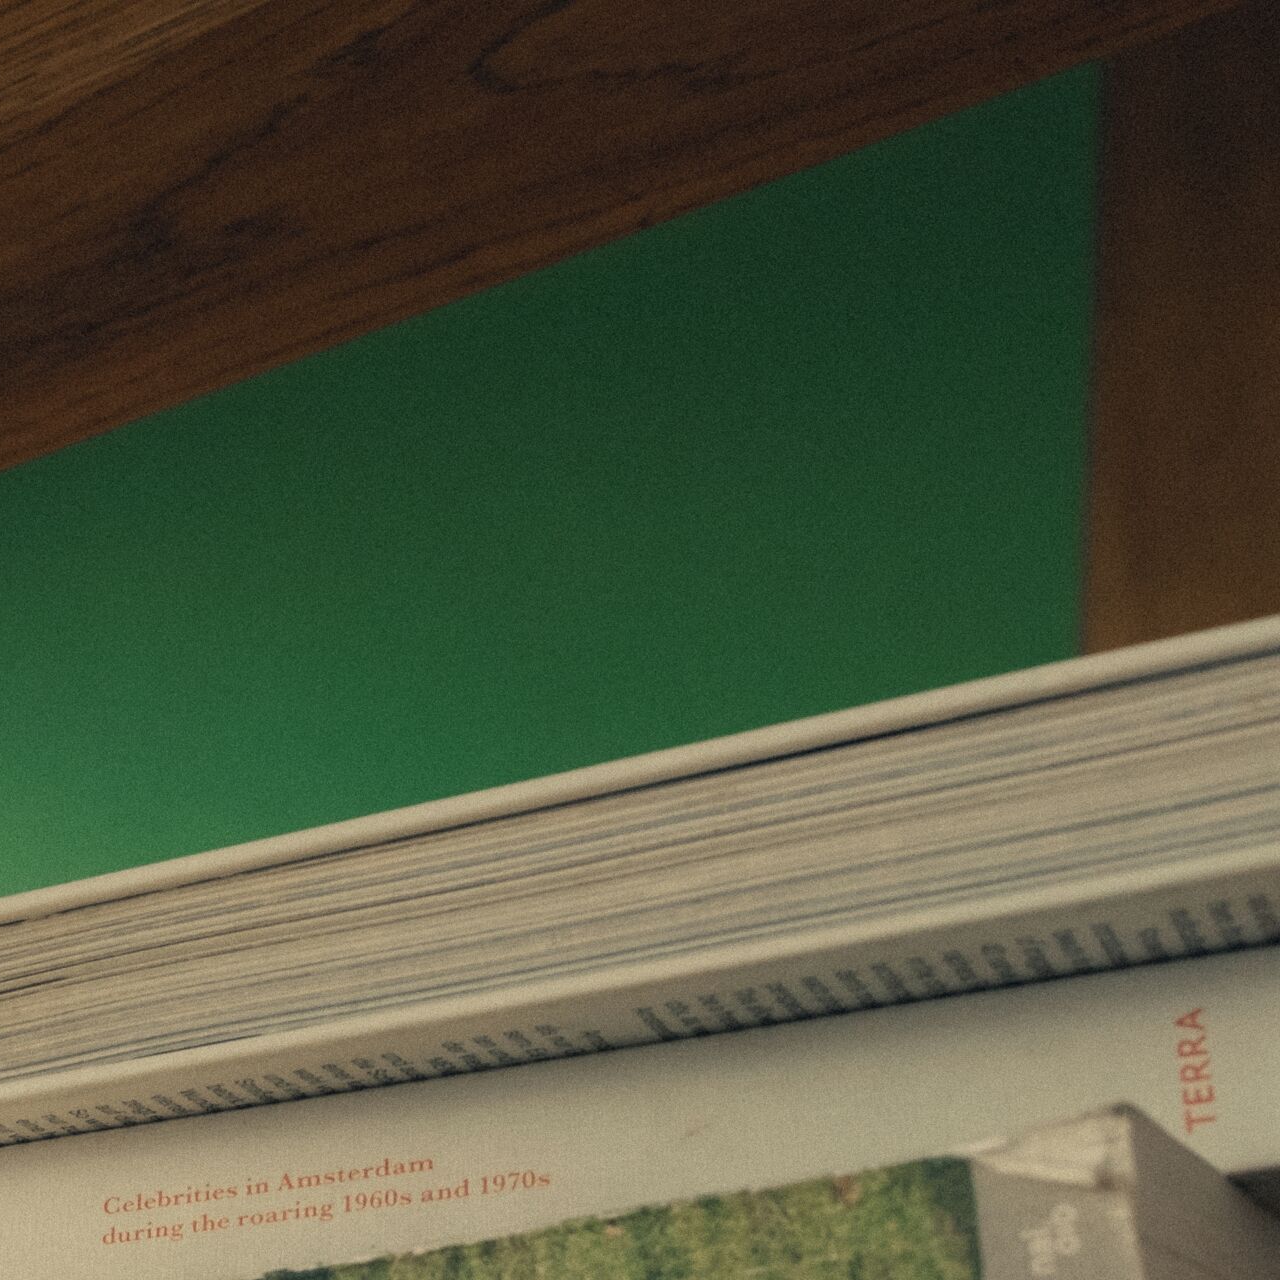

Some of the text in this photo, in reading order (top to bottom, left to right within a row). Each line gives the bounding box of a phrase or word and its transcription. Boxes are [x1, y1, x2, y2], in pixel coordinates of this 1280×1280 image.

[1174, 1006, 1218, 1134] TERRA
[101, 1168, 552, 1246] during the roaring 1960s and 1970s
[102, 1155, 434, 1216] Celebrities in Amsterdam
